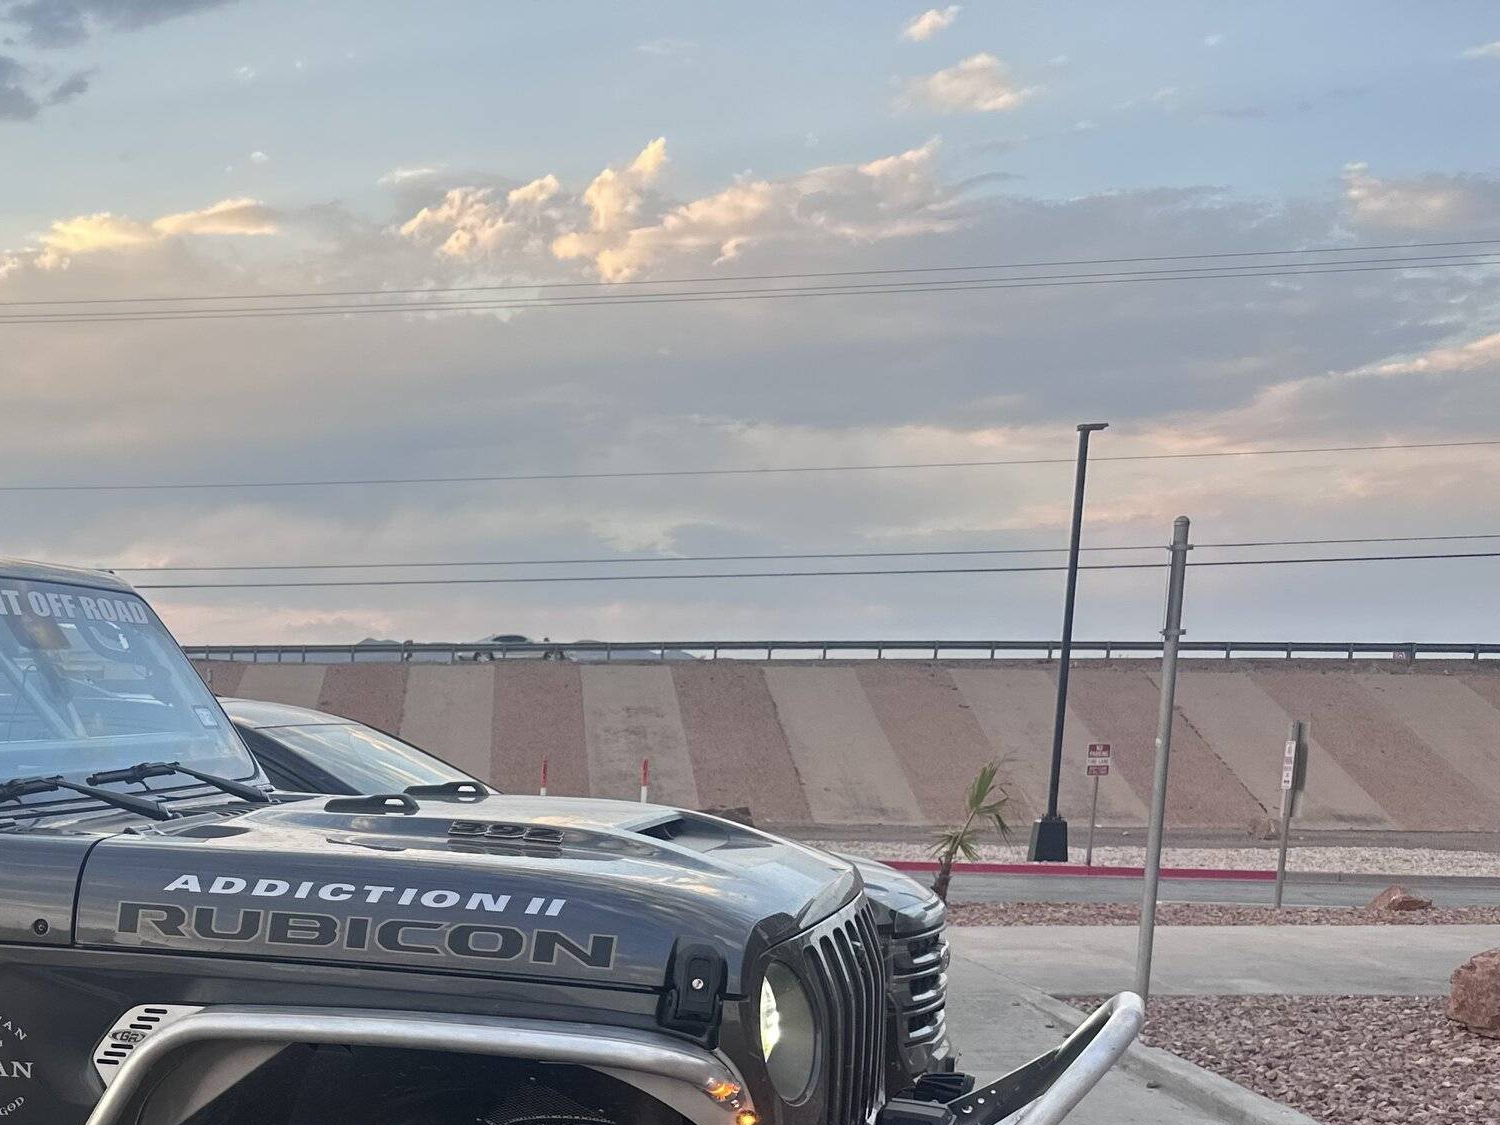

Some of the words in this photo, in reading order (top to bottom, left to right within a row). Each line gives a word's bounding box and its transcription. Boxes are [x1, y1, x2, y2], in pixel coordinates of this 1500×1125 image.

[28, 590, 76, 619] OFF
[80, 596, 149, 625] ROAD
[163, 874, 512, 912] ADDICTION
[524, 898, 567, 917] II
[116, 900, 618, 970] RUBICON
